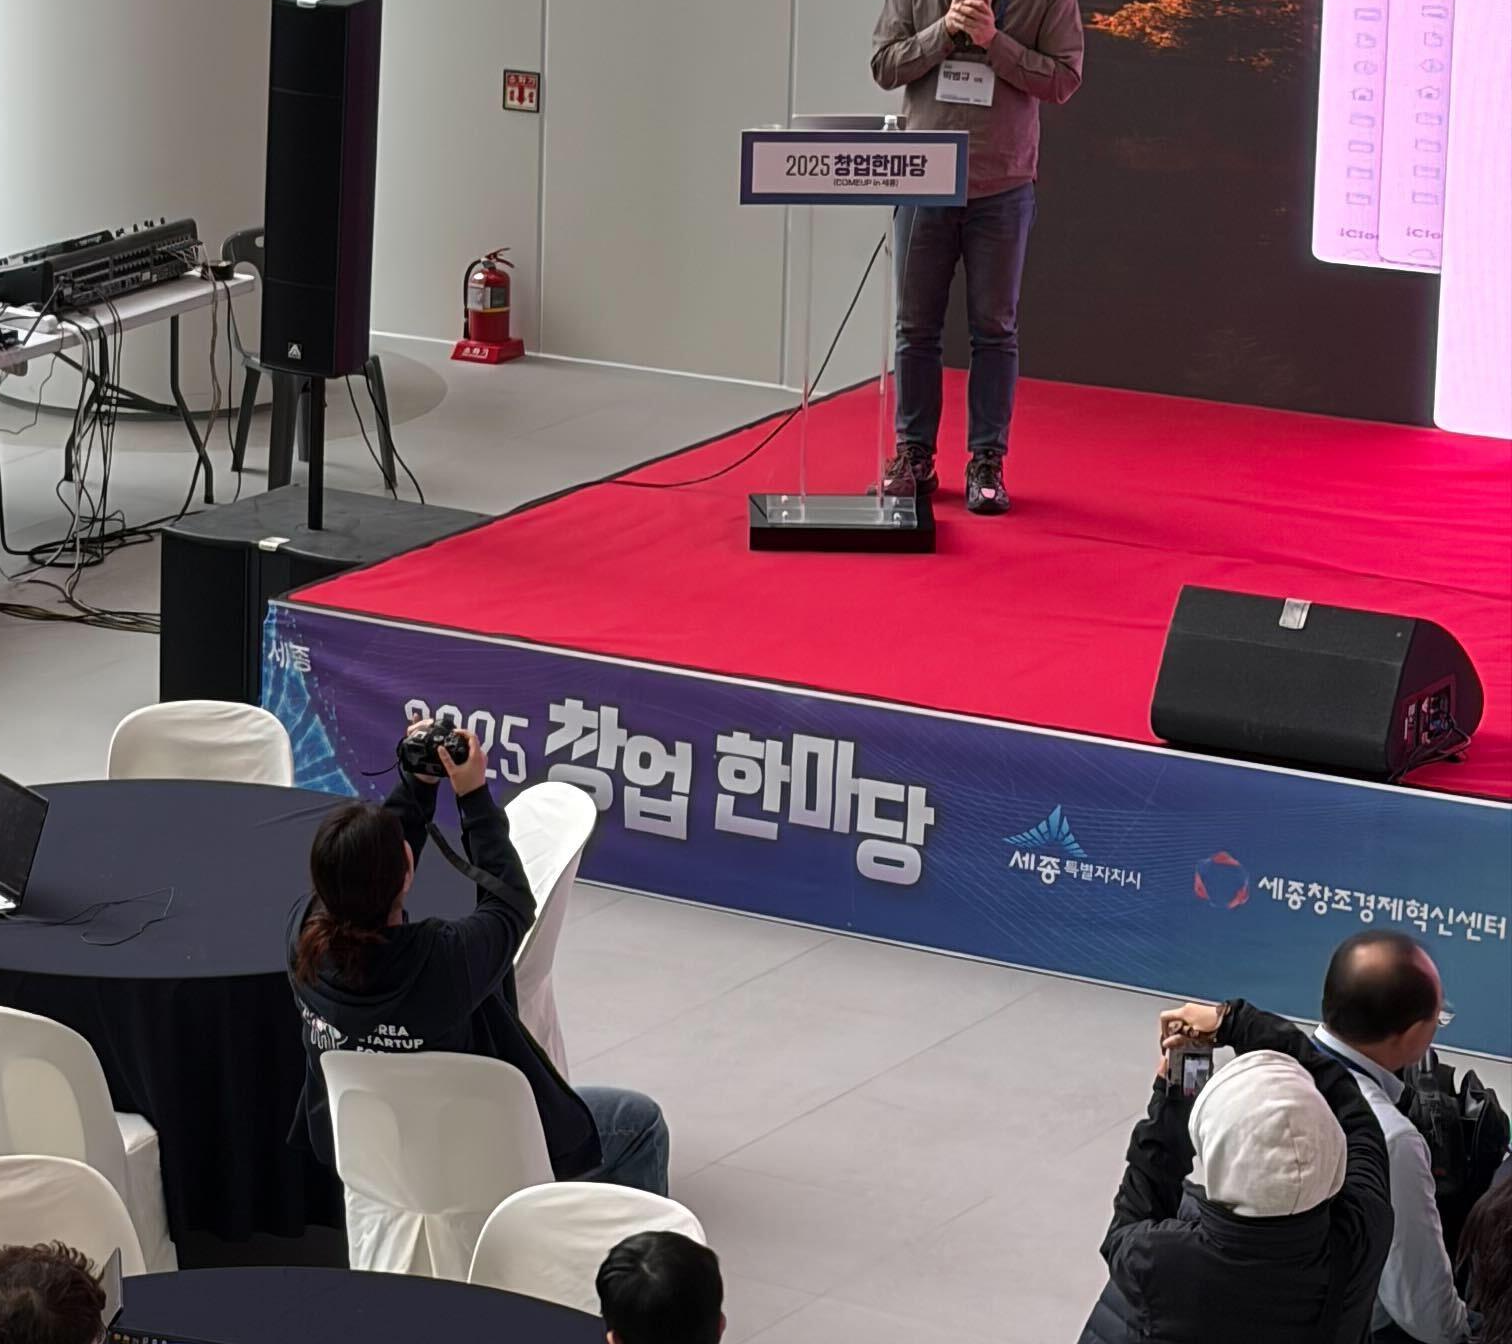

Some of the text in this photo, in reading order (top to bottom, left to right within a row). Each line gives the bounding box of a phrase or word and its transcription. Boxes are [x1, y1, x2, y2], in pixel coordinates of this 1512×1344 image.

[786, 153, 928, 177] 2025 창업한마당
[544, 697, 693, 842] 창업
[714, 730, 936, 886] 한마당
[1258, 875, 1507, 942] 세종창조경제혁신센터
